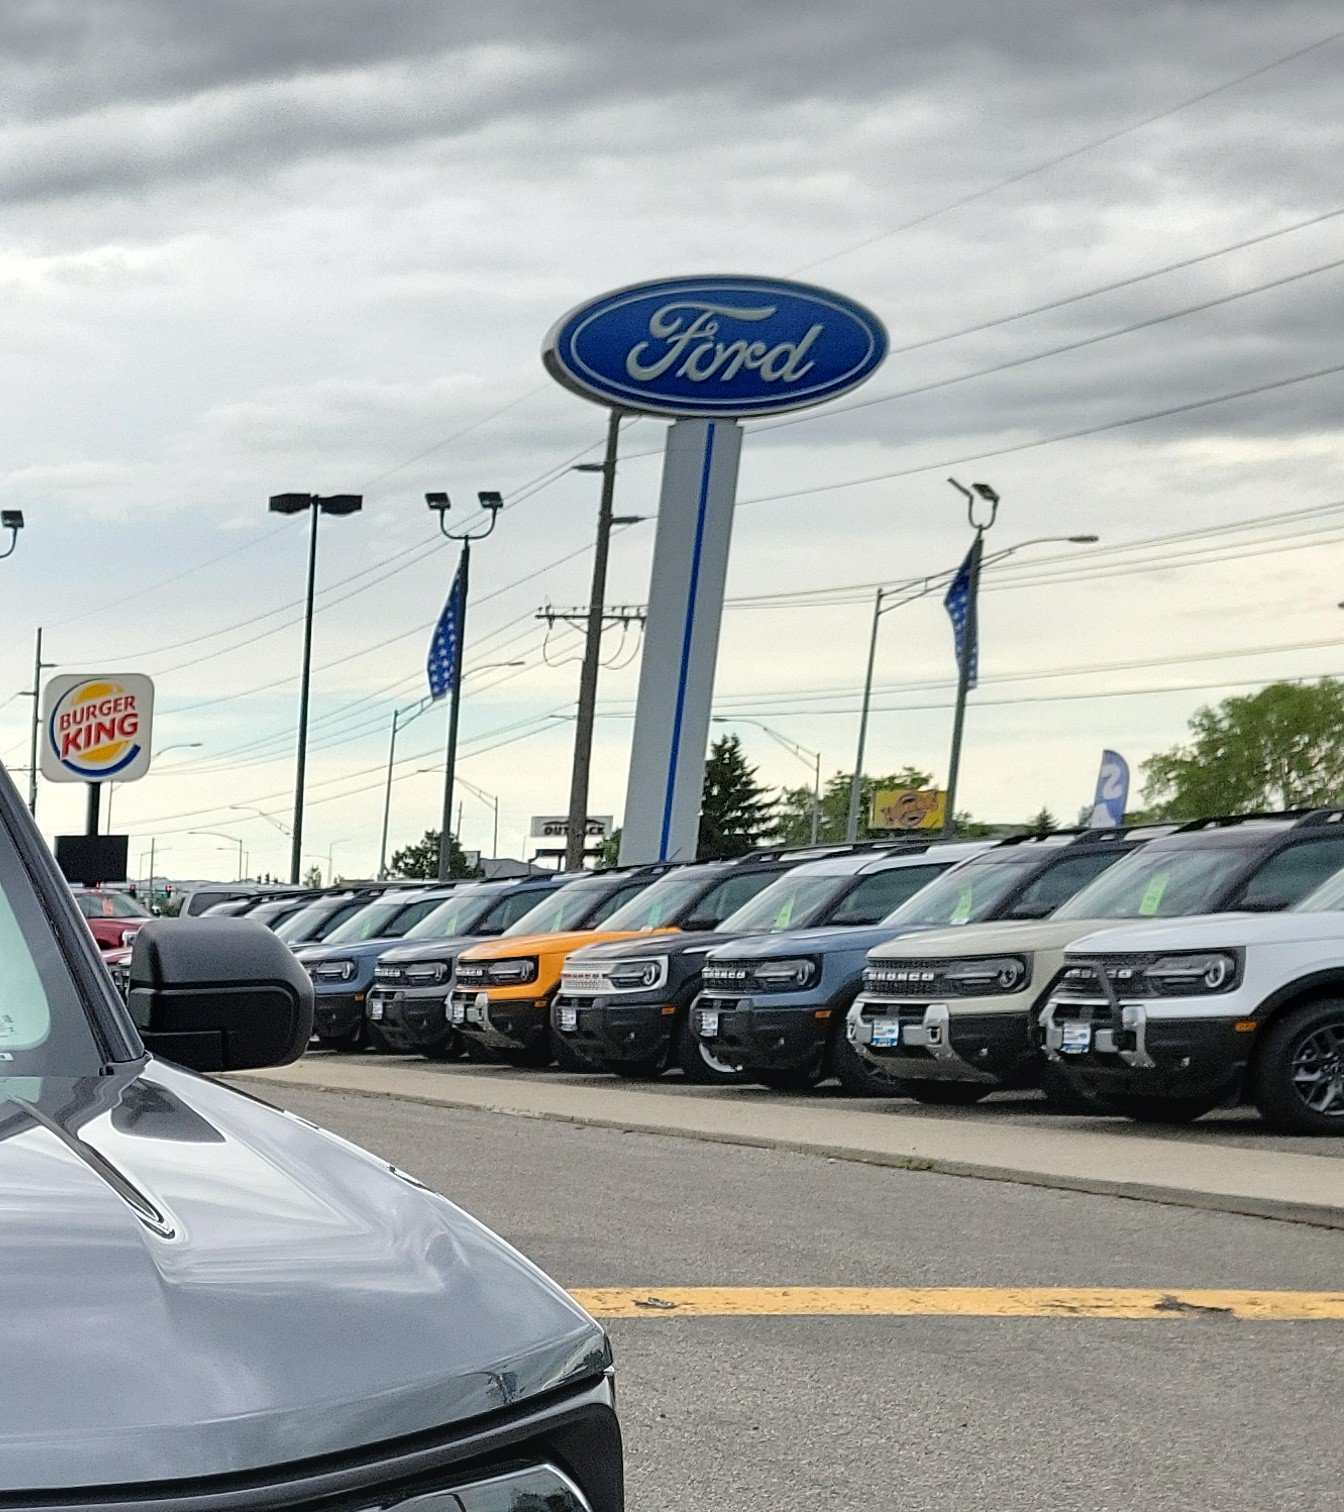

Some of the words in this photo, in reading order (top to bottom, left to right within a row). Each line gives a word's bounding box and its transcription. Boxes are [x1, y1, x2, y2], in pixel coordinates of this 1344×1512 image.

[626, 302, 824, 382] Ford
[59, 695, 137, 732] BURGER
[61, 712, 139, 758] KING
[543, 825, 605, 836] OUTCK
